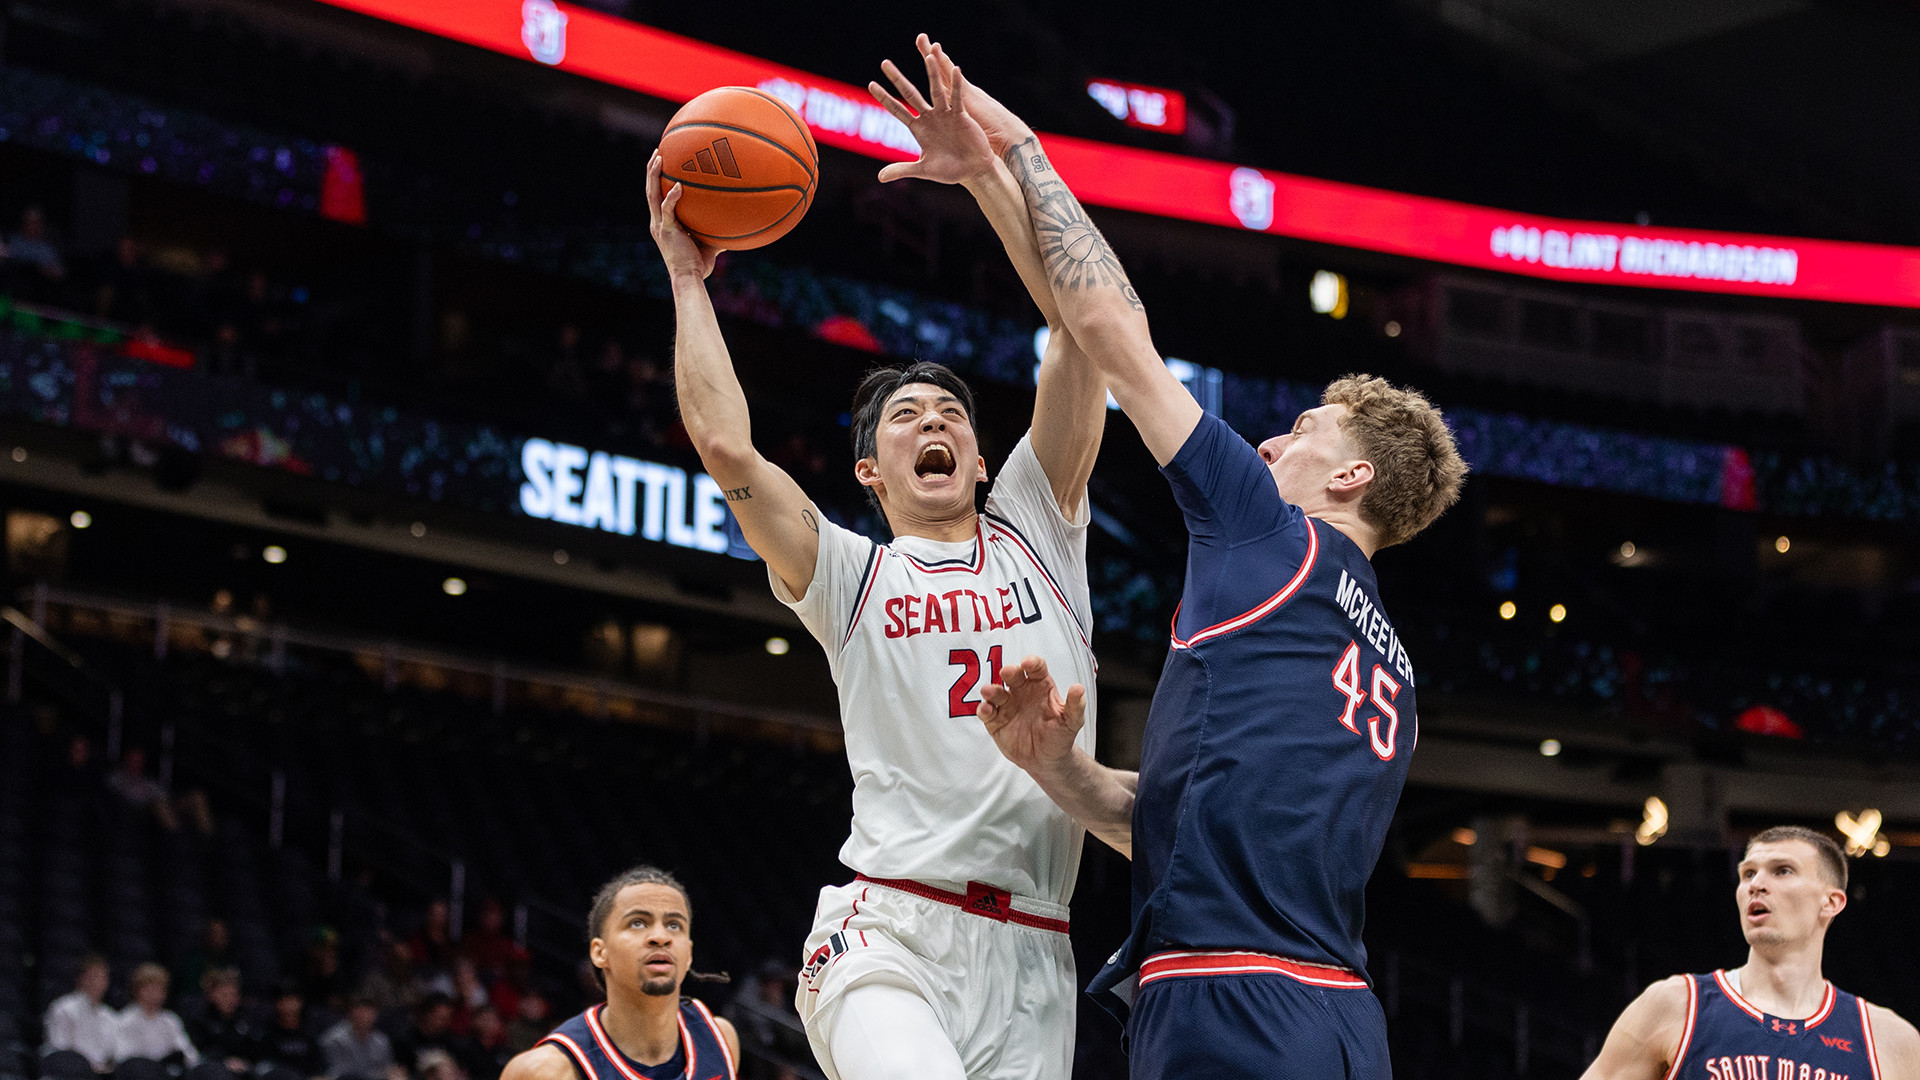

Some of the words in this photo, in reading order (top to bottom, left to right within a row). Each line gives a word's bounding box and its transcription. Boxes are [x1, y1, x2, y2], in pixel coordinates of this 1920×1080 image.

[520, 437, 729, 554] SEATTLE
[1335, 569, 1415, 688] MCKEEVER
[948, 644, 1006, 719] 21
[1331, 639, 1402, 762] 45
[972, 902, 1002, 915] adidas
[1705, 1055, 1770, 1080] SAINT
[1819, 1034, 1853, 1053] WCC
